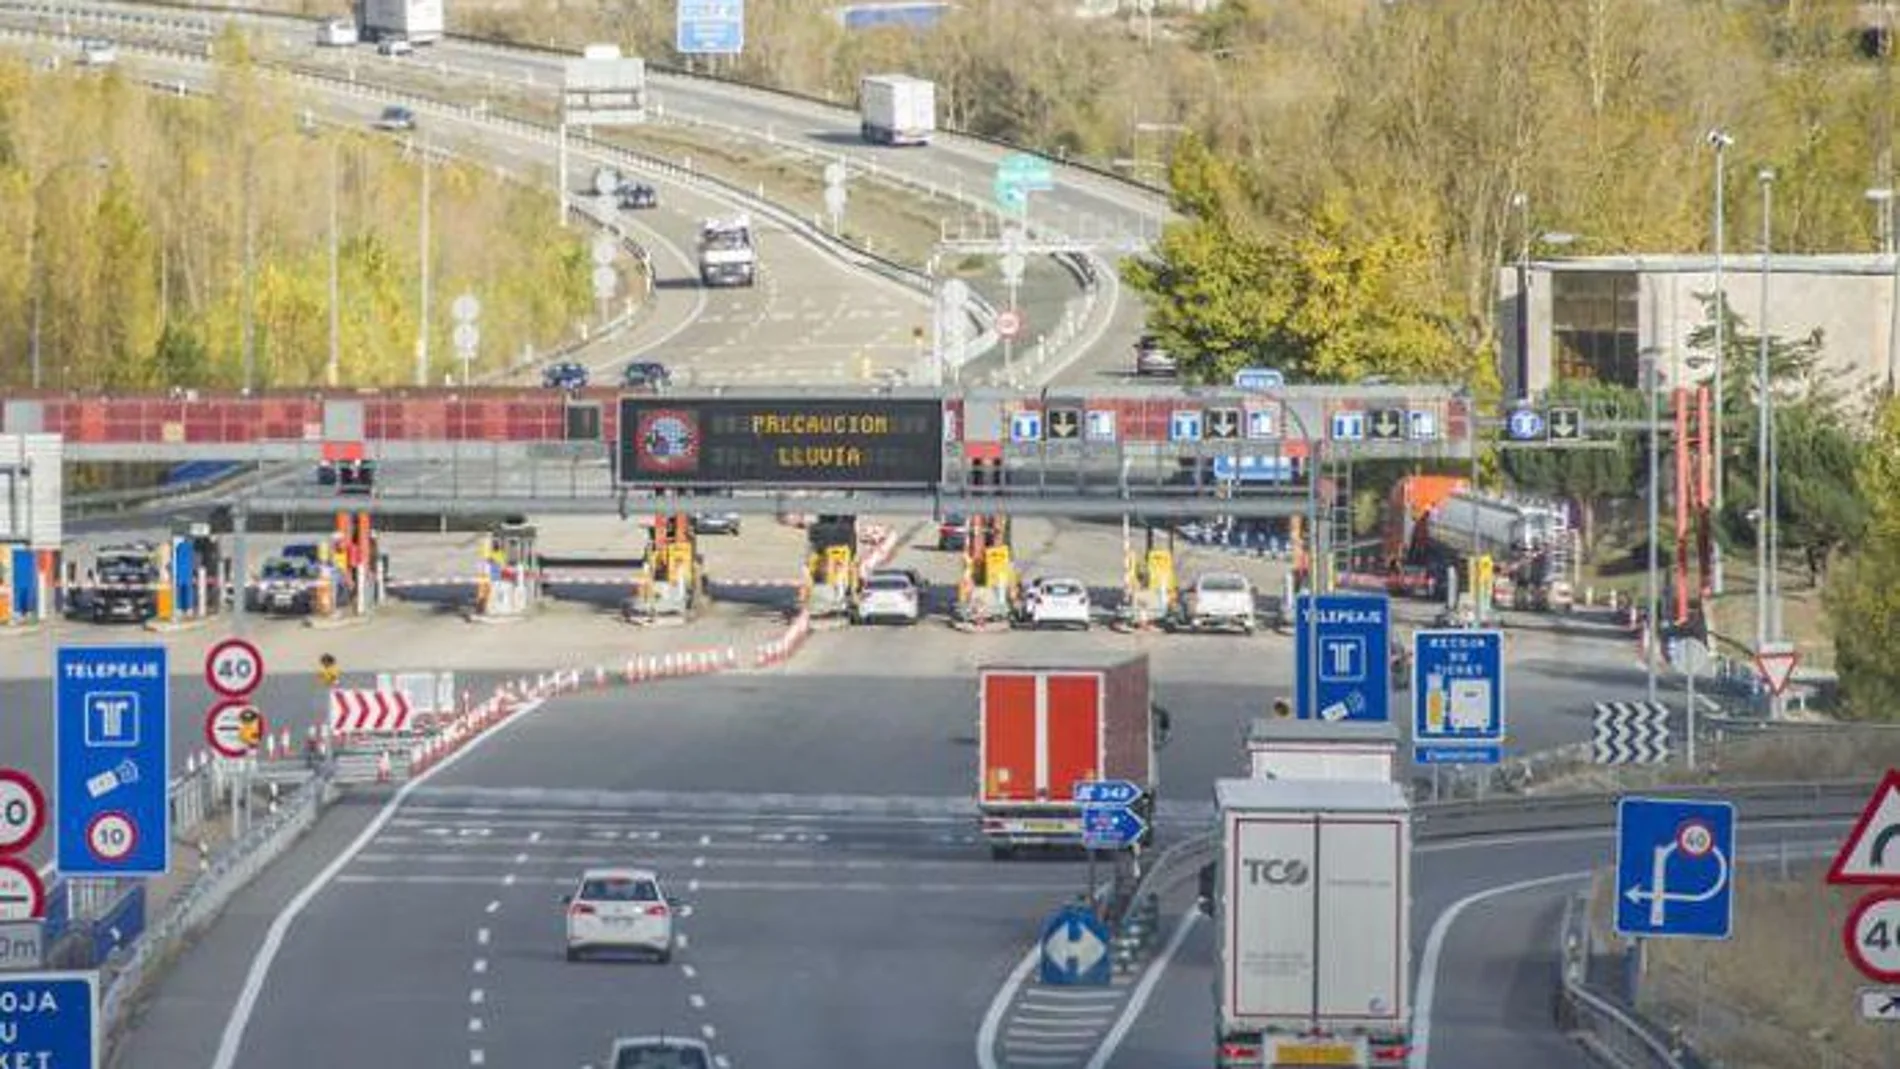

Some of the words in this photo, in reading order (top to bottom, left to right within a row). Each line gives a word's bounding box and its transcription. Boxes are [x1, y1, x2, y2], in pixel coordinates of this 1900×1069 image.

[778, 446, 860, 467] LLUVIA
[66, 662, 158, 679] TELEPEAJE
[218, 659, 251, 679] 40
[100, 828, 125, 846] 10
